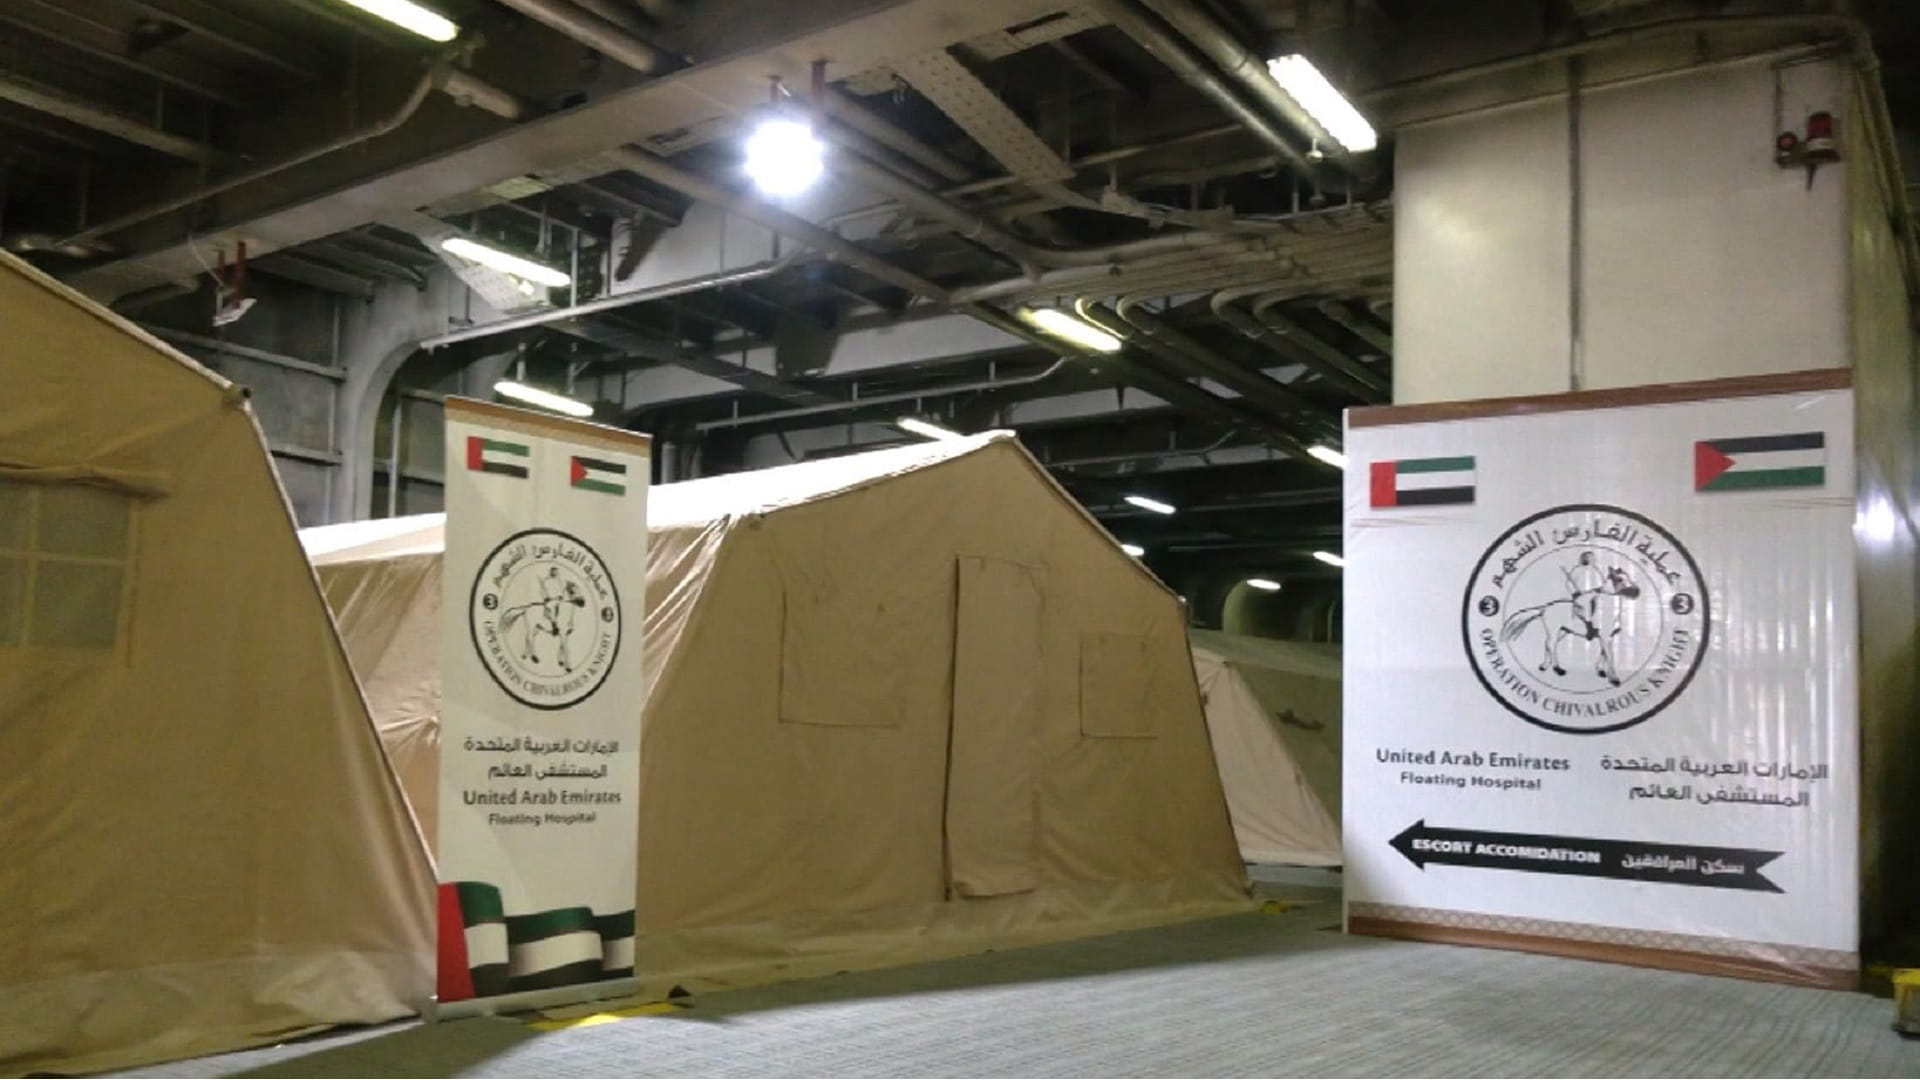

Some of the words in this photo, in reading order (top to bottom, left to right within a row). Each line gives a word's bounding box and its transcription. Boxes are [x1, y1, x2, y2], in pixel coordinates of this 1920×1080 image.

[1553, 518, 1637, 546] الفارس
[1491, 530, 1545, 589] الشهم
[1481, 628, 1539, 704] OPERATION
[1542, 685, 1651, 718] CHIVALROUS
[1650, 629, 1690, 689] KNIGHT
[524, 737, 571, 755] العربية
[1376, 748, 1436, 765] United
[1440, 750, 1484, 767] Arab
[1489, 752, 1571, 770] Emirates
[1600, 755, 1675, 772] المتحدة
[1680, 755, 1749, 778] العربية
[1400, 771, 1467, 788] Floating
[1471, 776, 1542, 791] Hospital
[463, 790, 517, 805] United
[521, 790, 558, 805] Arab
[560, 790, 622, 805] Emirates
[489, 812, 541, 827] Floating
[544, 812, 596, 826] Hospital
[1411, 838, 1473, 854] ESCORT
[1475, 843, 1601, 864] ACCOMIDATION
